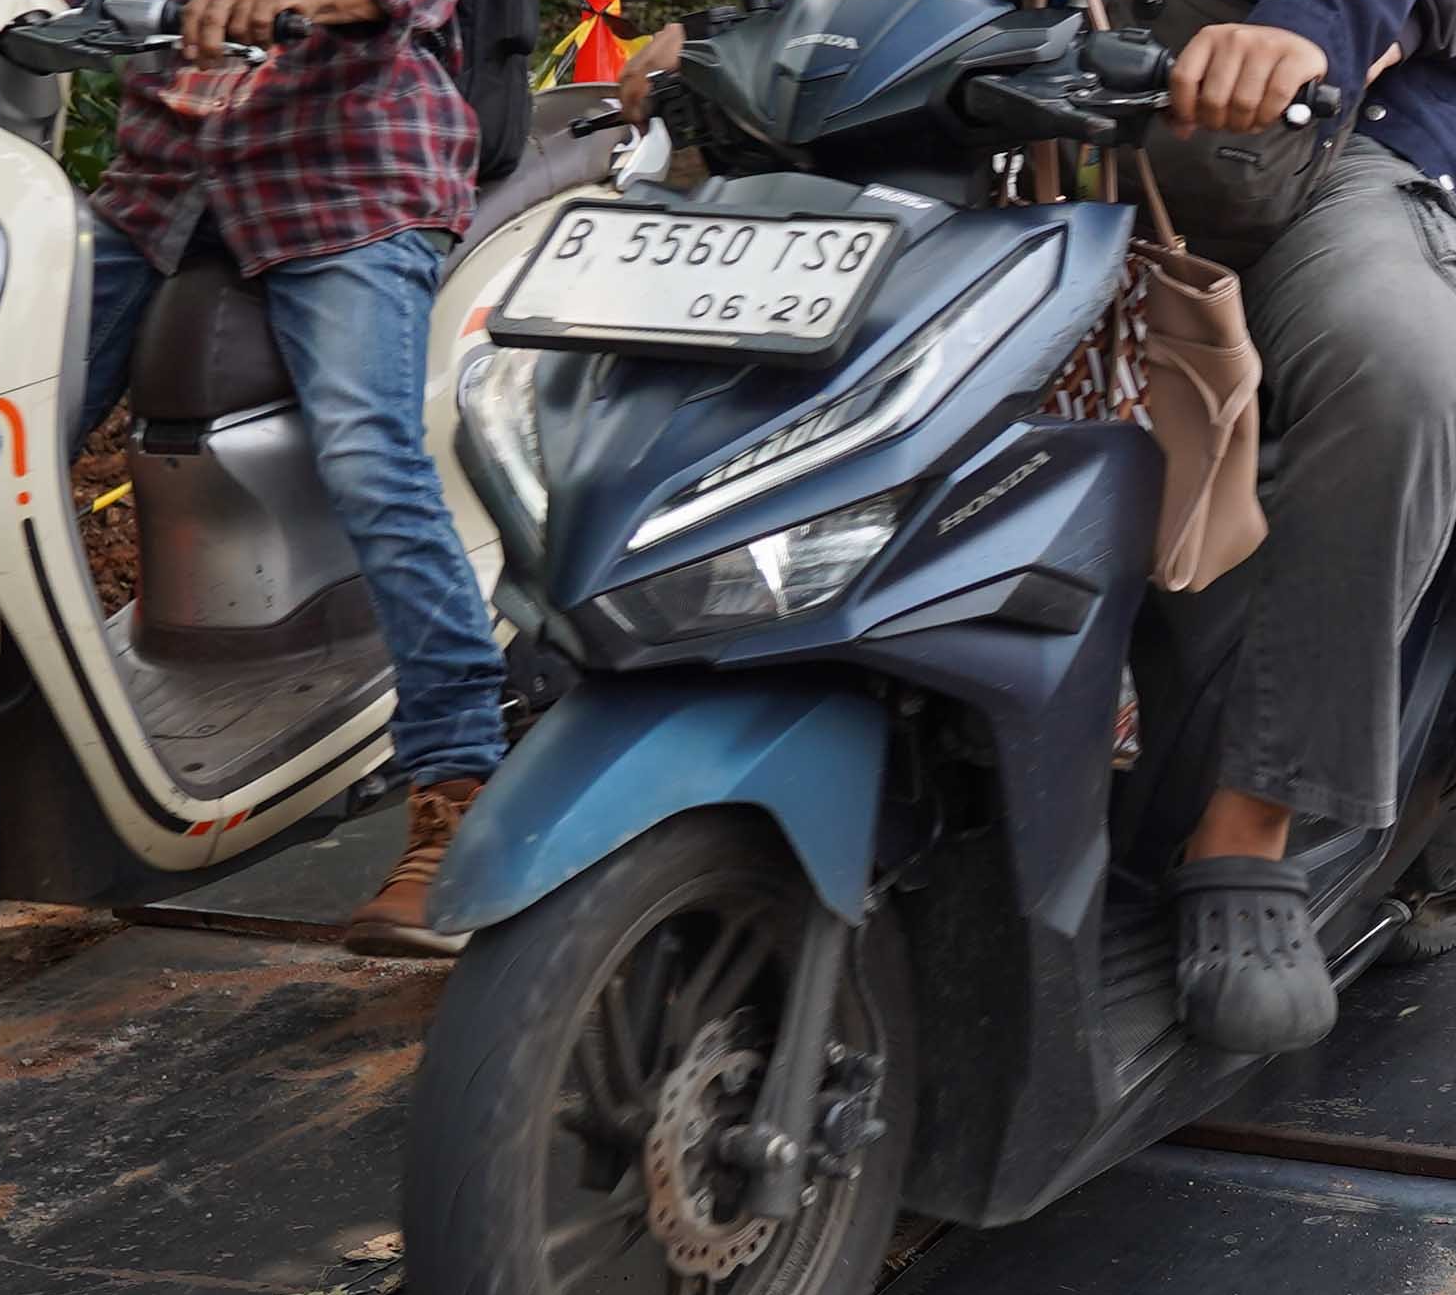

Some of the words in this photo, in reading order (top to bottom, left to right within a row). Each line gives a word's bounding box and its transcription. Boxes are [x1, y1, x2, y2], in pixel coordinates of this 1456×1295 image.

[555, 218, 596, 260] B
[618, 220, 759, 267] 5560
[937, 450, 1052, 536] HONDA
